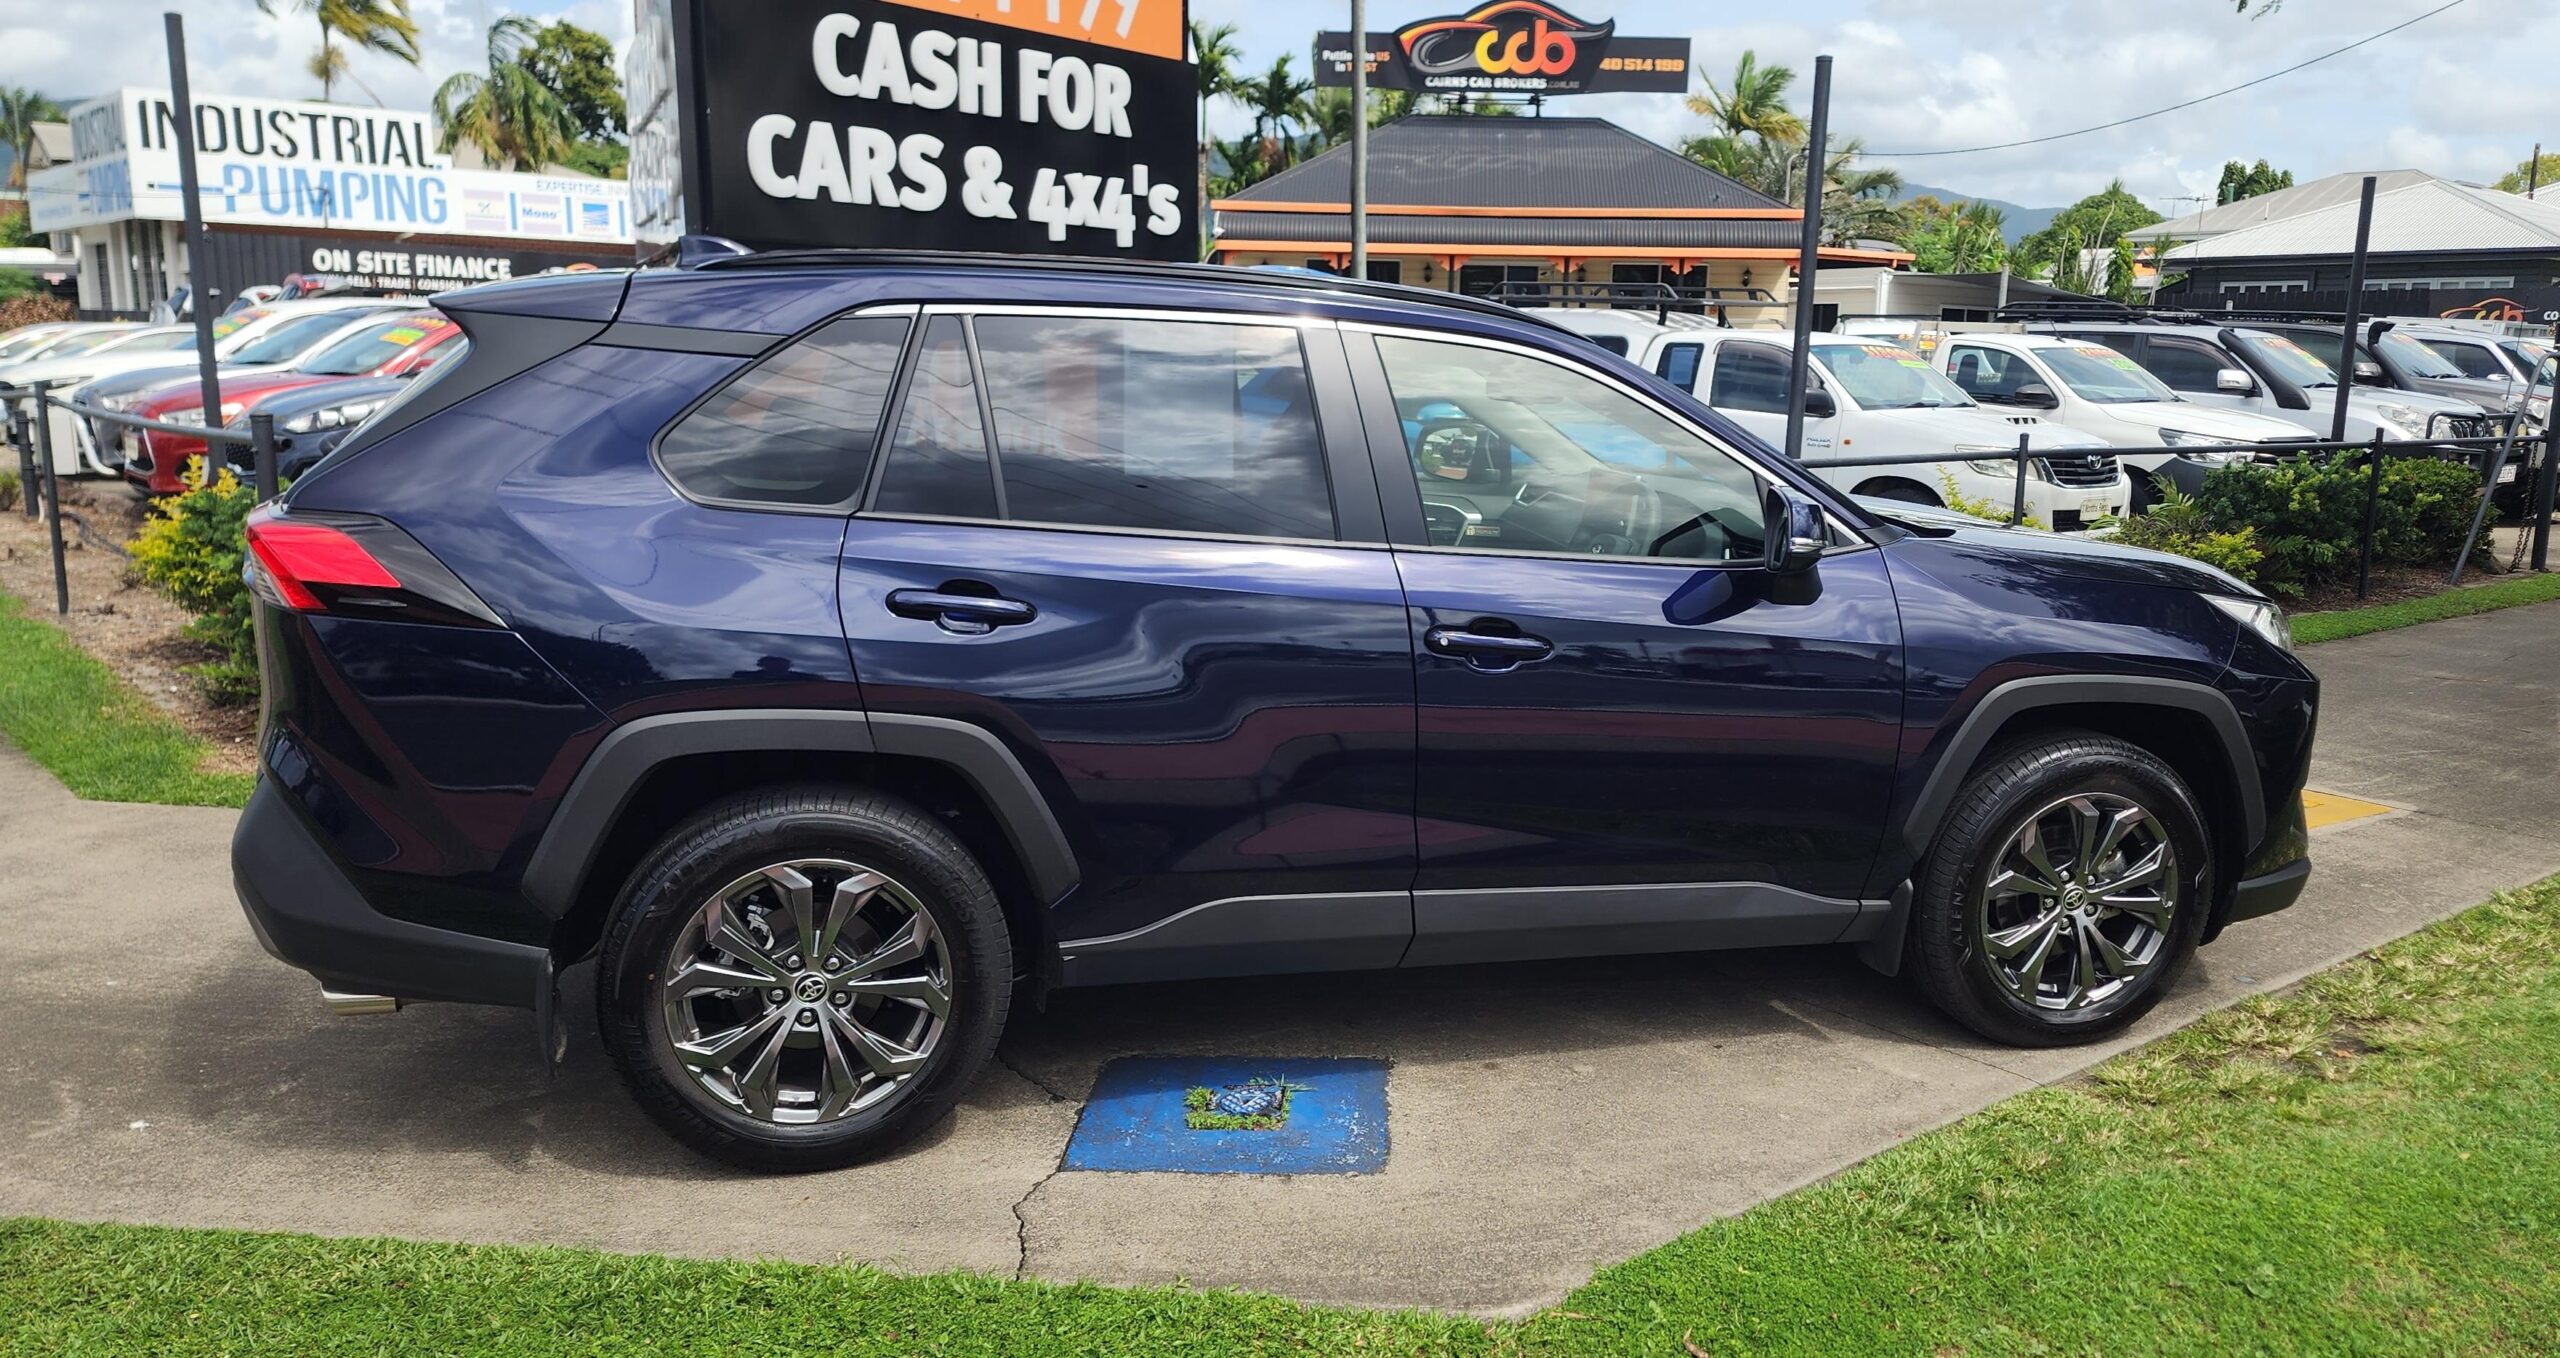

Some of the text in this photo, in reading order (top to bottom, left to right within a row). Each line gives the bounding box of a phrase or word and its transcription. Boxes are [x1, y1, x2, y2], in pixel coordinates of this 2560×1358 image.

[1322, 50, 1353, 62] Puttin
[1346, 62, 1378, 72] TST
[1623, 57, 1653, 71] 514
[812, 13, 1003, 118] CASH
[1018, 47, 1132, 138] FOR
[1425, 76, 1468, 88] CAIRNS
[1469, 77, 1493, 88] CAR
[138, 100, 434, 169] INDUSTRIAL
[747, 114, 948, 212] CARS
[962, 145, 1017, 220] &
[222, 163, 447, 224] PUMPING
[312, 248, 512, 280] ON SITE FINANCE
[377, 277, 411, 290] TRADE
